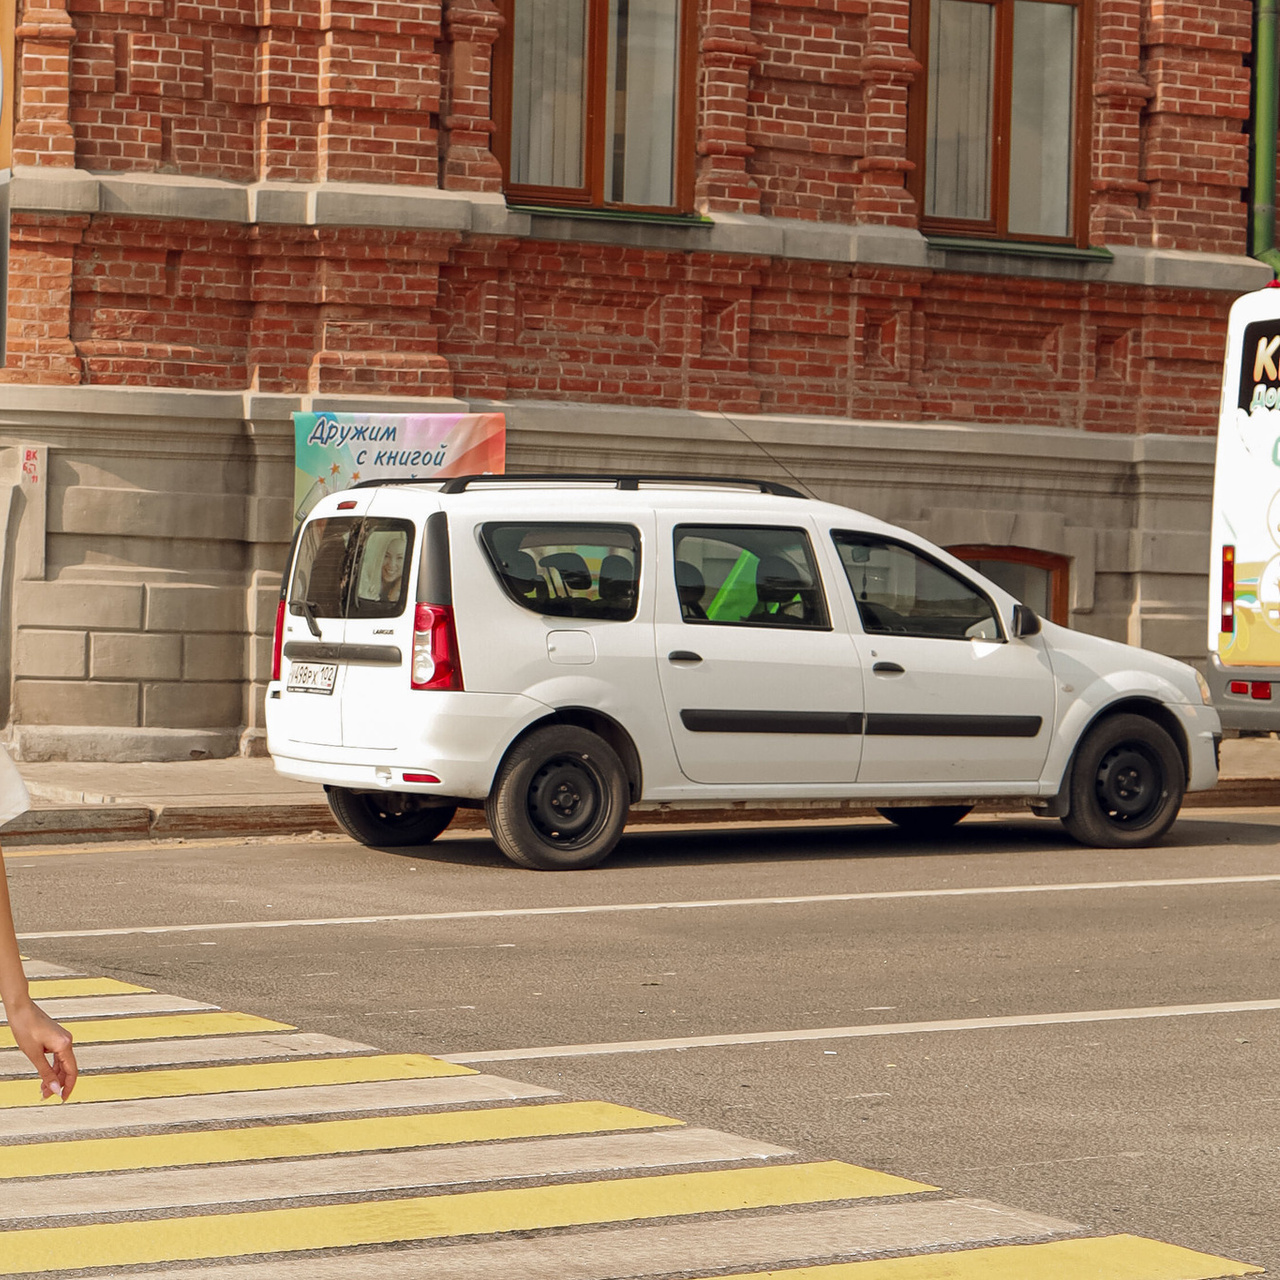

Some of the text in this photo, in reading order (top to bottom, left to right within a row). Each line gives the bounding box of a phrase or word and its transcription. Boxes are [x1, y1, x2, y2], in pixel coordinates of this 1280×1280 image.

[309, 418, 397, 447] Дружим
[356, 443, 448, 467] с книгой
